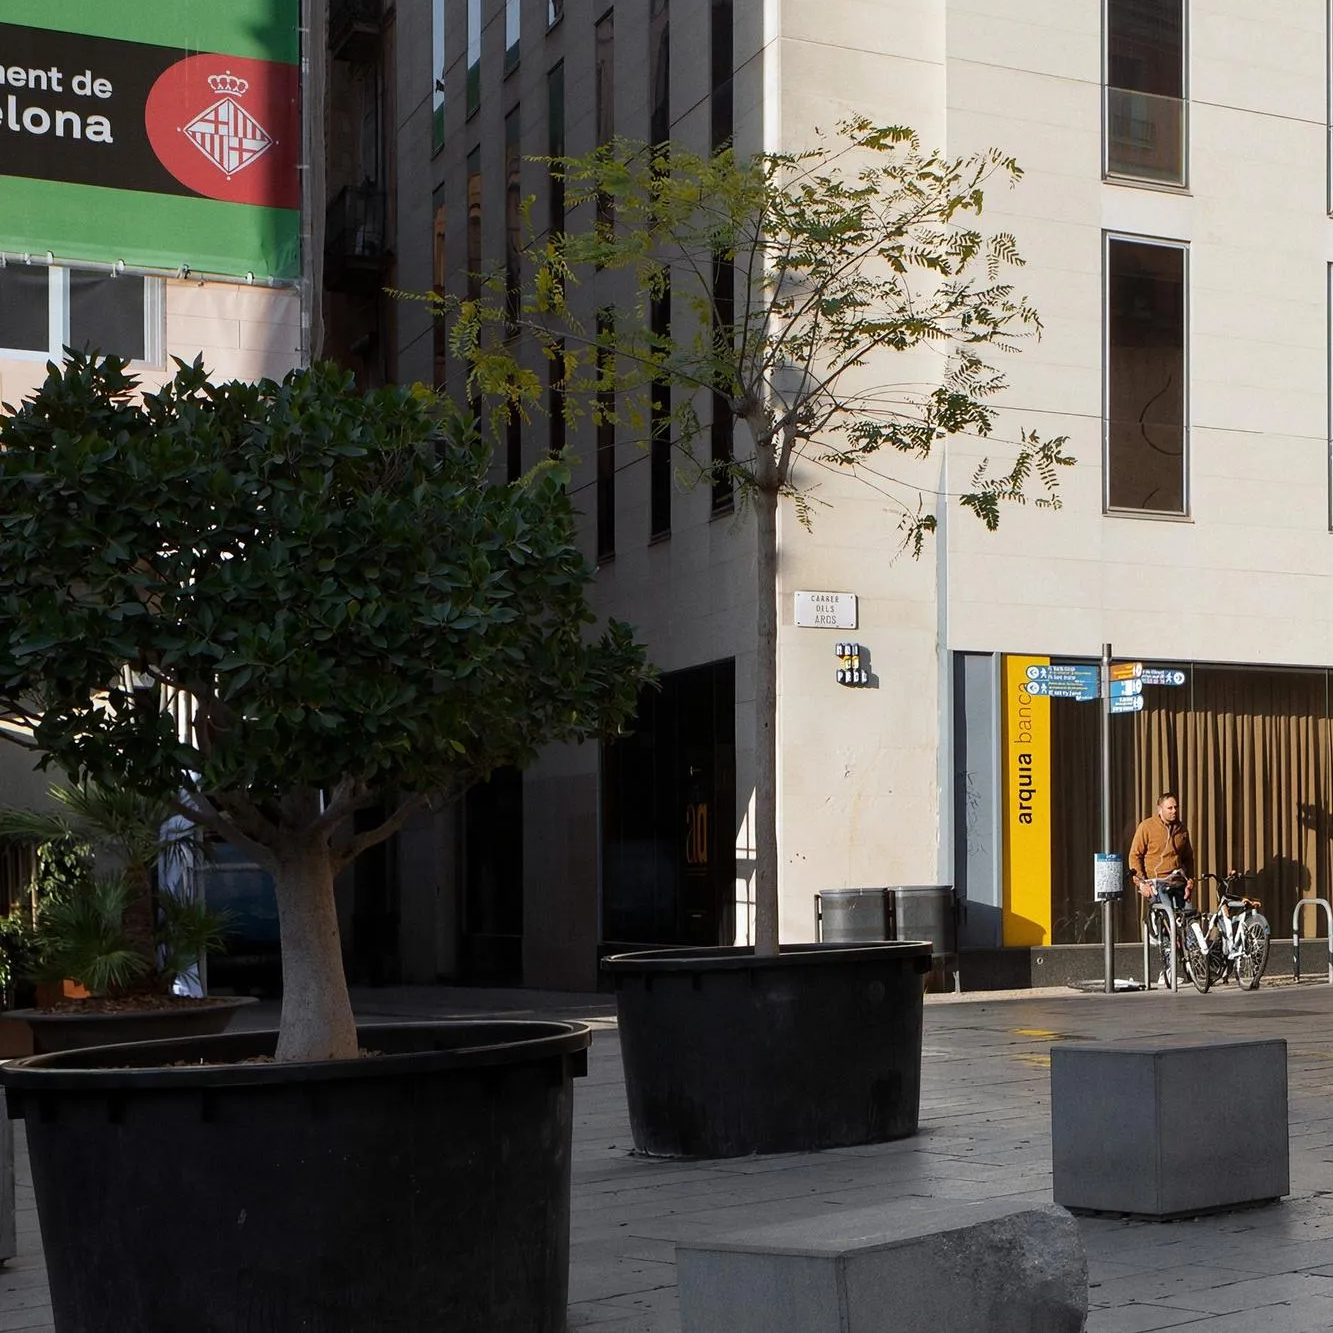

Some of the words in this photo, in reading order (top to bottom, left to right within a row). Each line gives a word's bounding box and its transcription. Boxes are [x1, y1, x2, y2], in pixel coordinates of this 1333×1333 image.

[0, 65, 63, 93] ent
[72, 70, 113, 99] de
[0, 94, 114, 144] lona
[1018, 753, 1036, 824] arquia
